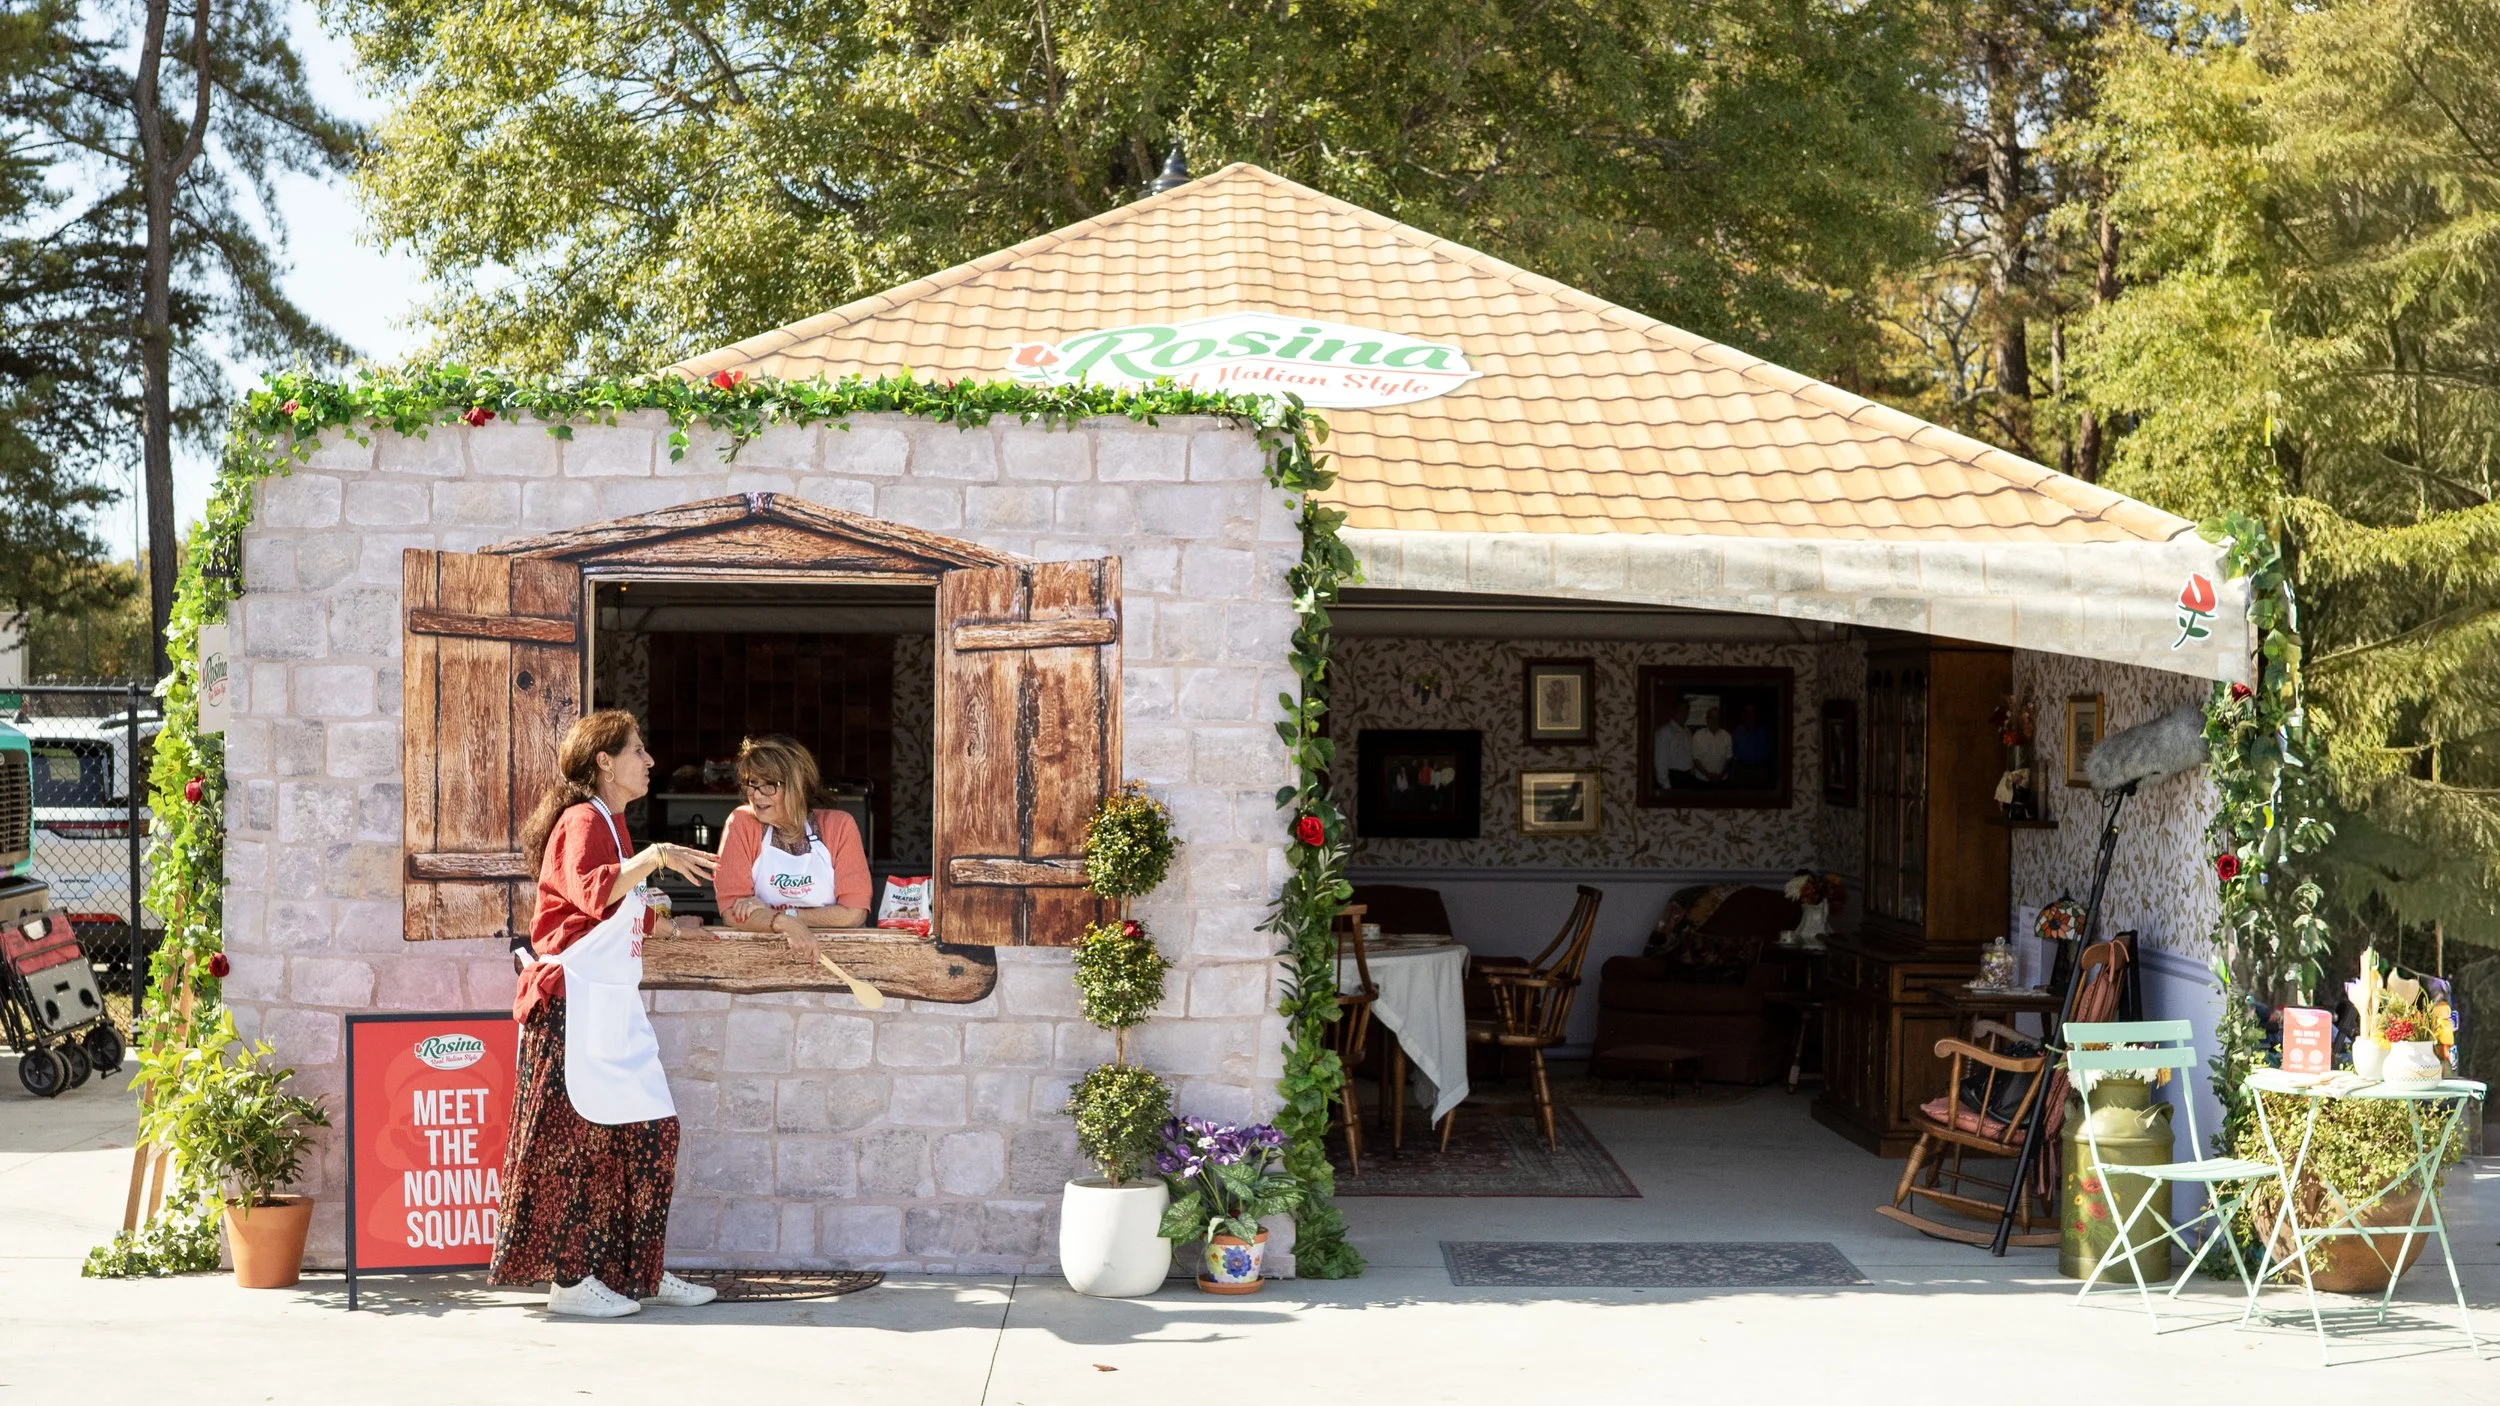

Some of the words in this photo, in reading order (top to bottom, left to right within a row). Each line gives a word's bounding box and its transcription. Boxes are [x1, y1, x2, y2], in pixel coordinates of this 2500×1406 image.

[1062, 327, 1453, 379] Rosina
[1218, 366, 1327, 388] Italian
[1343, 372, 1429, 397] Style
[422, 1037, 481, 1059] Rosina
[413, 1088, 488, 1125] MEET
[424, 1129, 479, 1165] THE
[404, 1168, 500, 1207] NONNA
[407, 1208, 499, 1249] SQUAD
